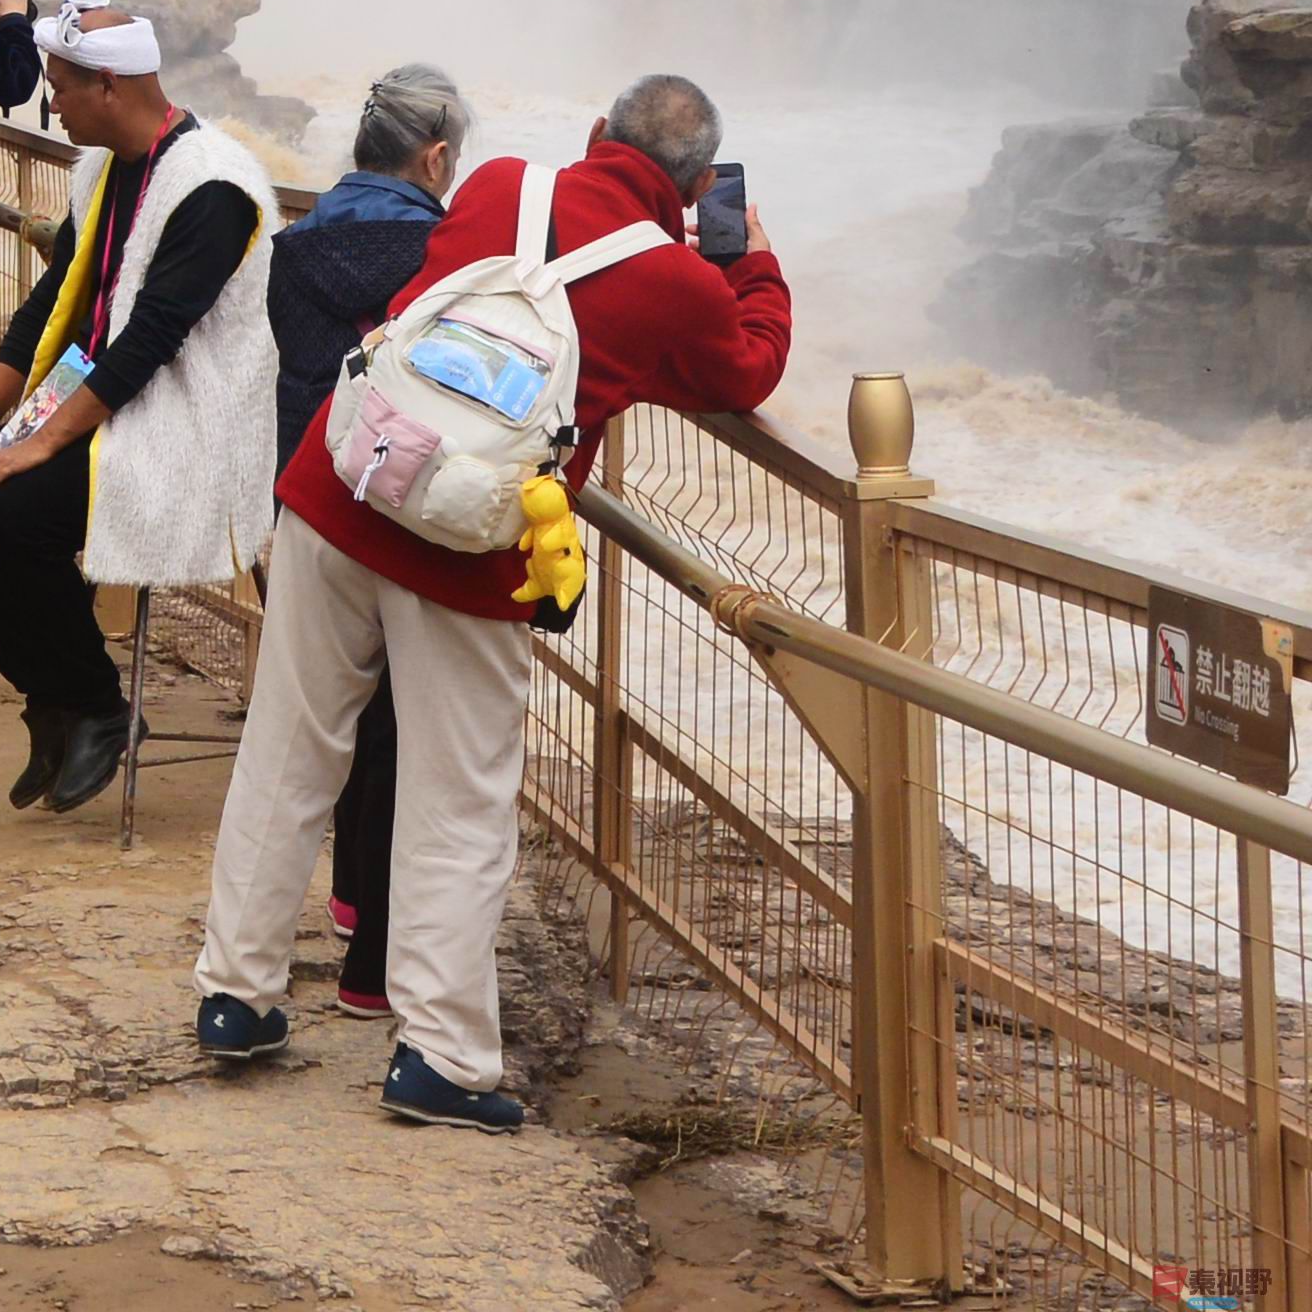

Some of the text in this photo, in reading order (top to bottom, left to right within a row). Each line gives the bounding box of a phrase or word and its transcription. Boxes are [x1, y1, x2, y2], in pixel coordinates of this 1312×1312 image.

[1195, 644, 1271, 718] 禁止翻越
[1206, 710, 1240, 743] Crossing
